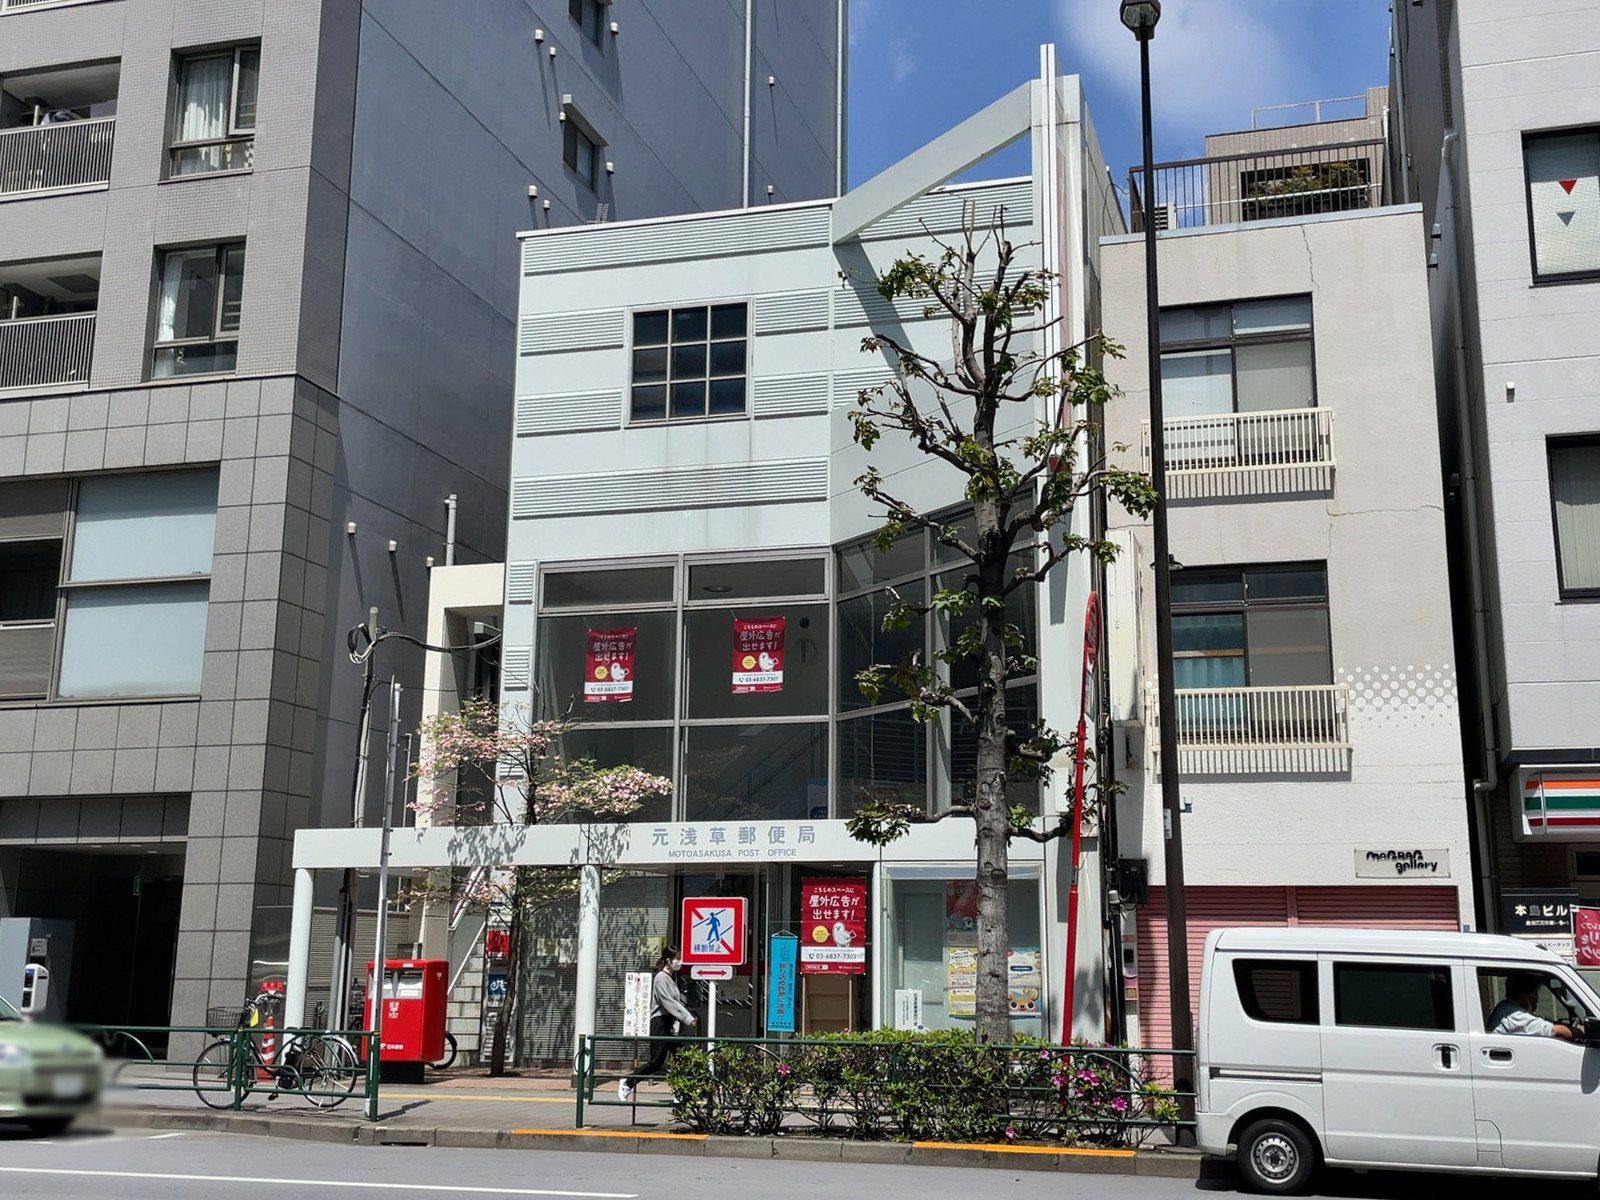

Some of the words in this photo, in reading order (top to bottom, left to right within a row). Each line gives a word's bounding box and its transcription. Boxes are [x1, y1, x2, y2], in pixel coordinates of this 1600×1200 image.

[739, 630, 781, 641] 屋外広告が
[593, 641, 633, 651] 屋外広告が
[652, 825, 816, 846] 元浅草郵便局
[668, 849, 732, 858] MOTOASAKUSA
[738, 849, 760, 857] POST
[768, 848, 797, 857] OFFICE
[809, 895, 860, 907] 屋外広告が
[1514, 904, 1568, 917] 本島ビル
[693, 944, 722, 953] 横断禁止
